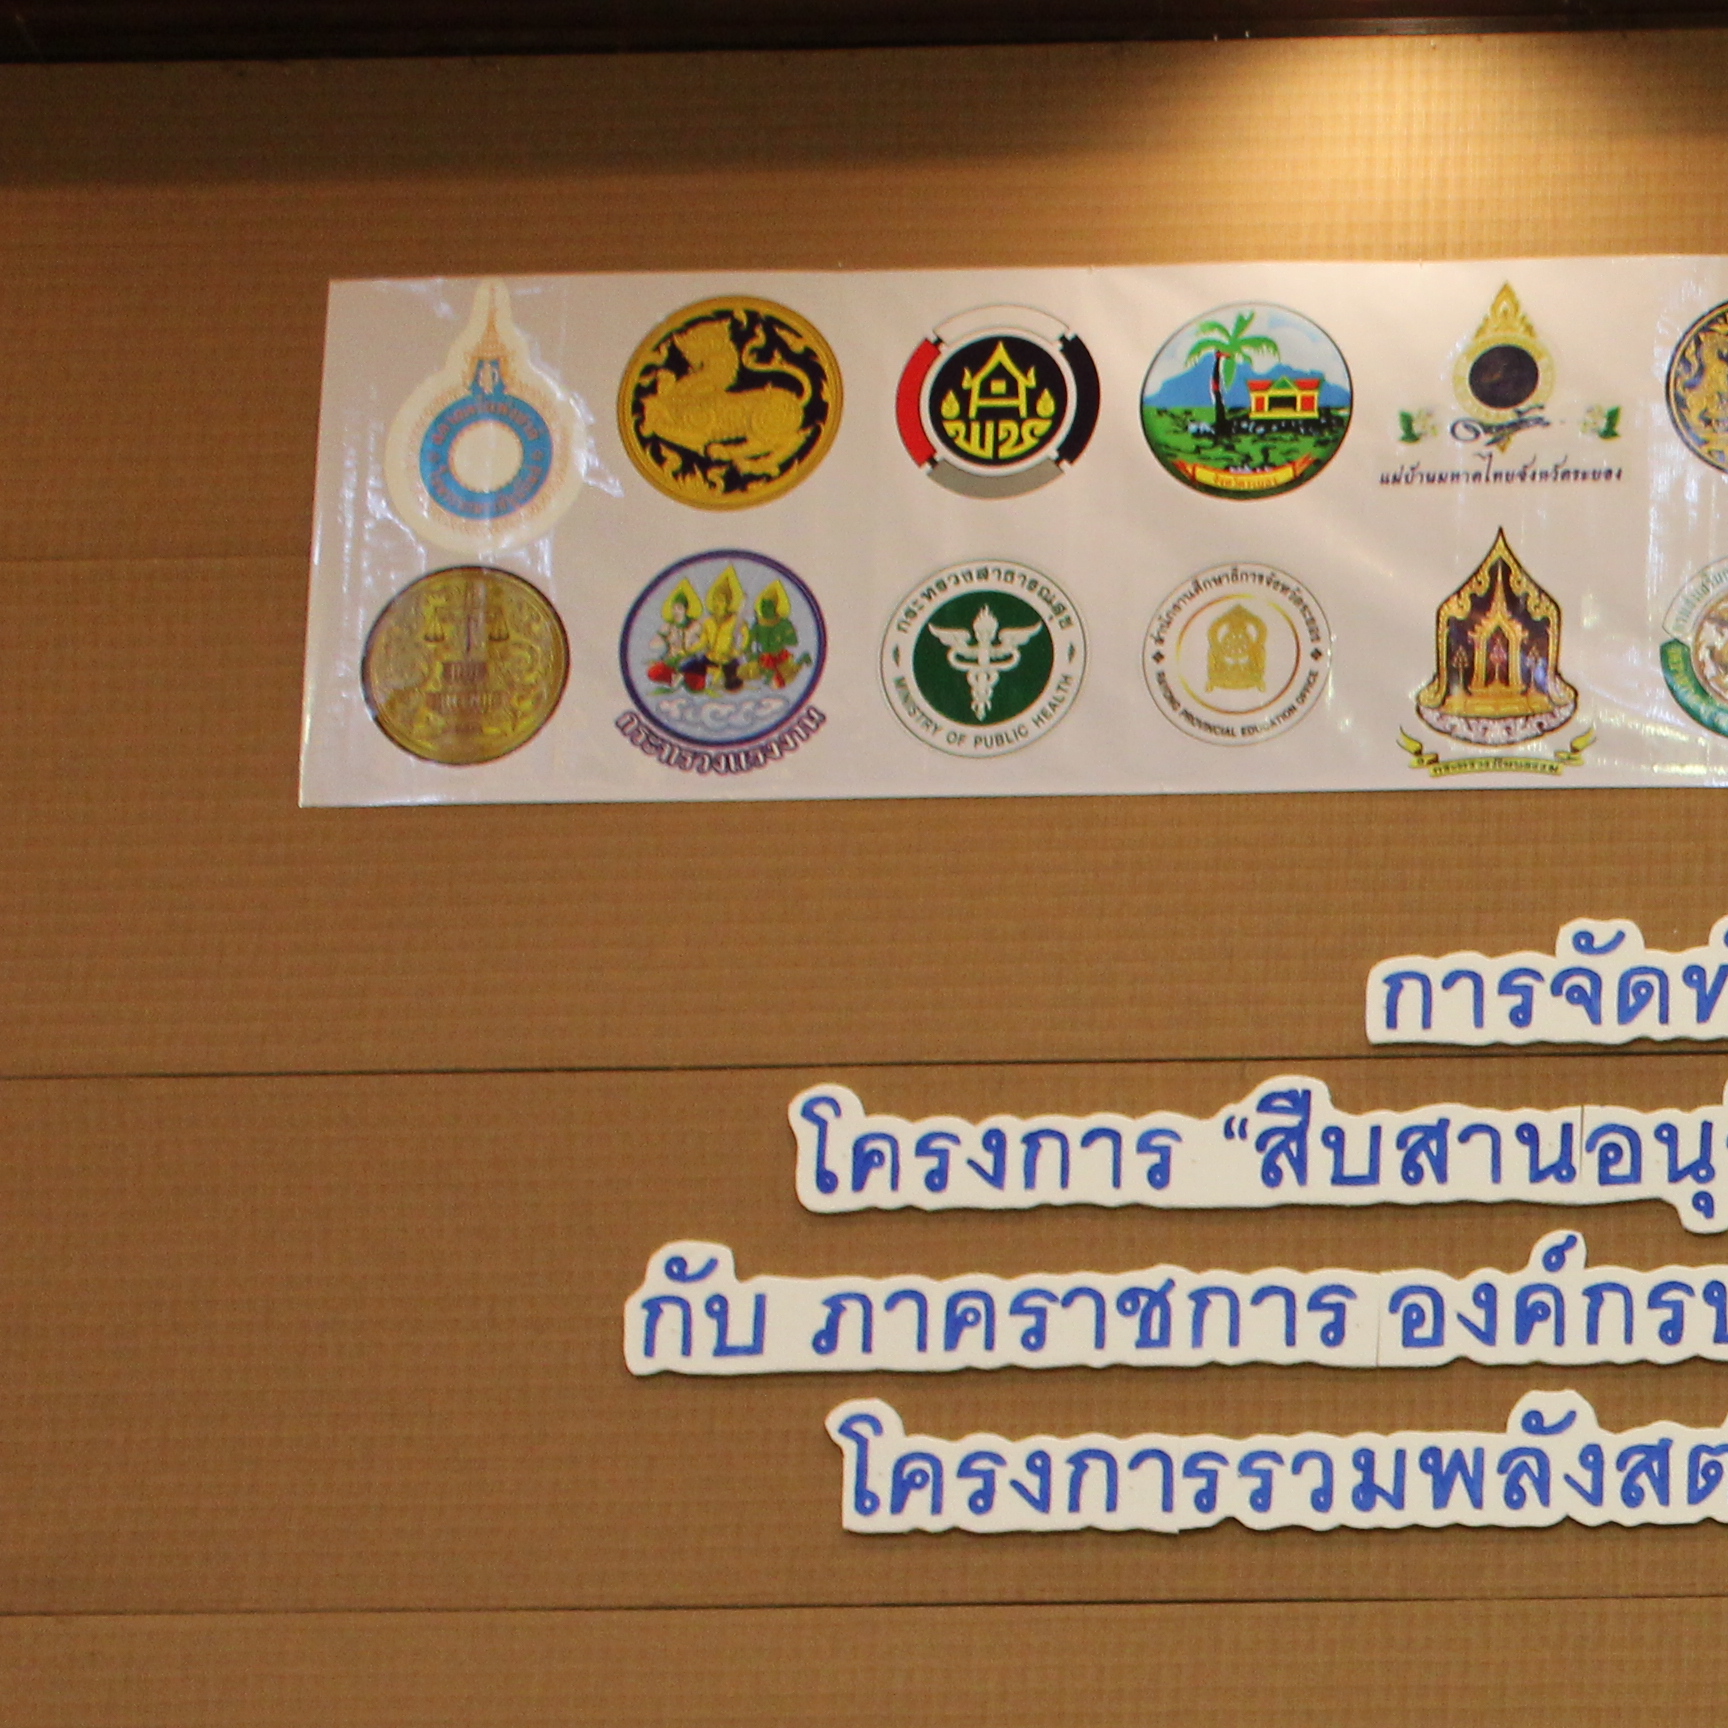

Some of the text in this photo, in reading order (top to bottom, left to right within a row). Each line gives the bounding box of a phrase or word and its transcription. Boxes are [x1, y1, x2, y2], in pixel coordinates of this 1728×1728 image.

[895, 565, 1074, 635] กระทรวงสาธารณสุข
[614, 705, 827, 775] กระทรวงแรงงาน
[894, 673, 1075, 749] MINISTRY OF PUBLIC HEALTH
[801, 1094, 1181, 1194] โครงการ
[642, 1255, 765, 1357] กับ
[812, 1278, 1356, 1355] ภาคราชการ
